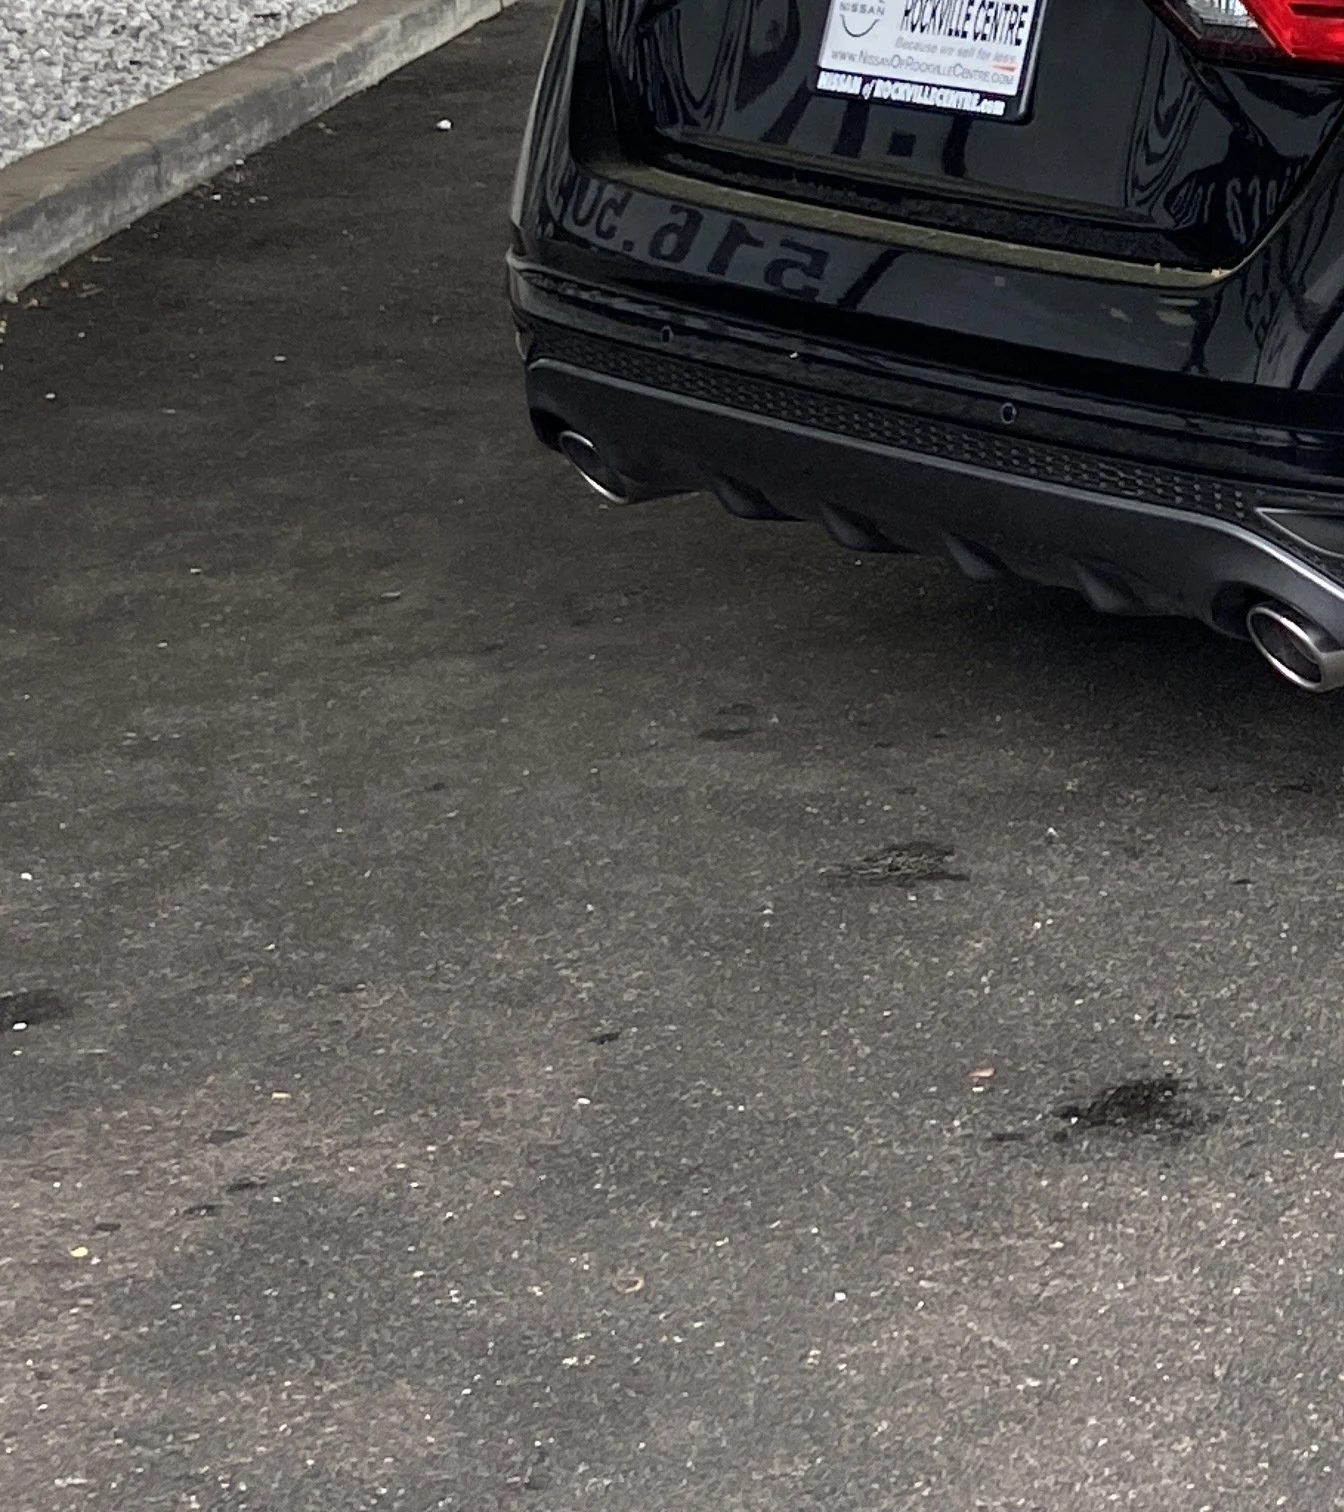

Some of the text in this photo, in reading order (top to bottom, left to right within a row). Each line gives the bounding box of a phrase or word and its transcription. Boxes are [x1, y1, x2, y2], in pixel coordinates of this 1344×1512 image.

[839, 1, 886, 17] NISSAN
[971, 1, 1030, 47] CENTRE
[895, 37, 938, 55] Because
[816, 70, 863, 95] NISSAN
